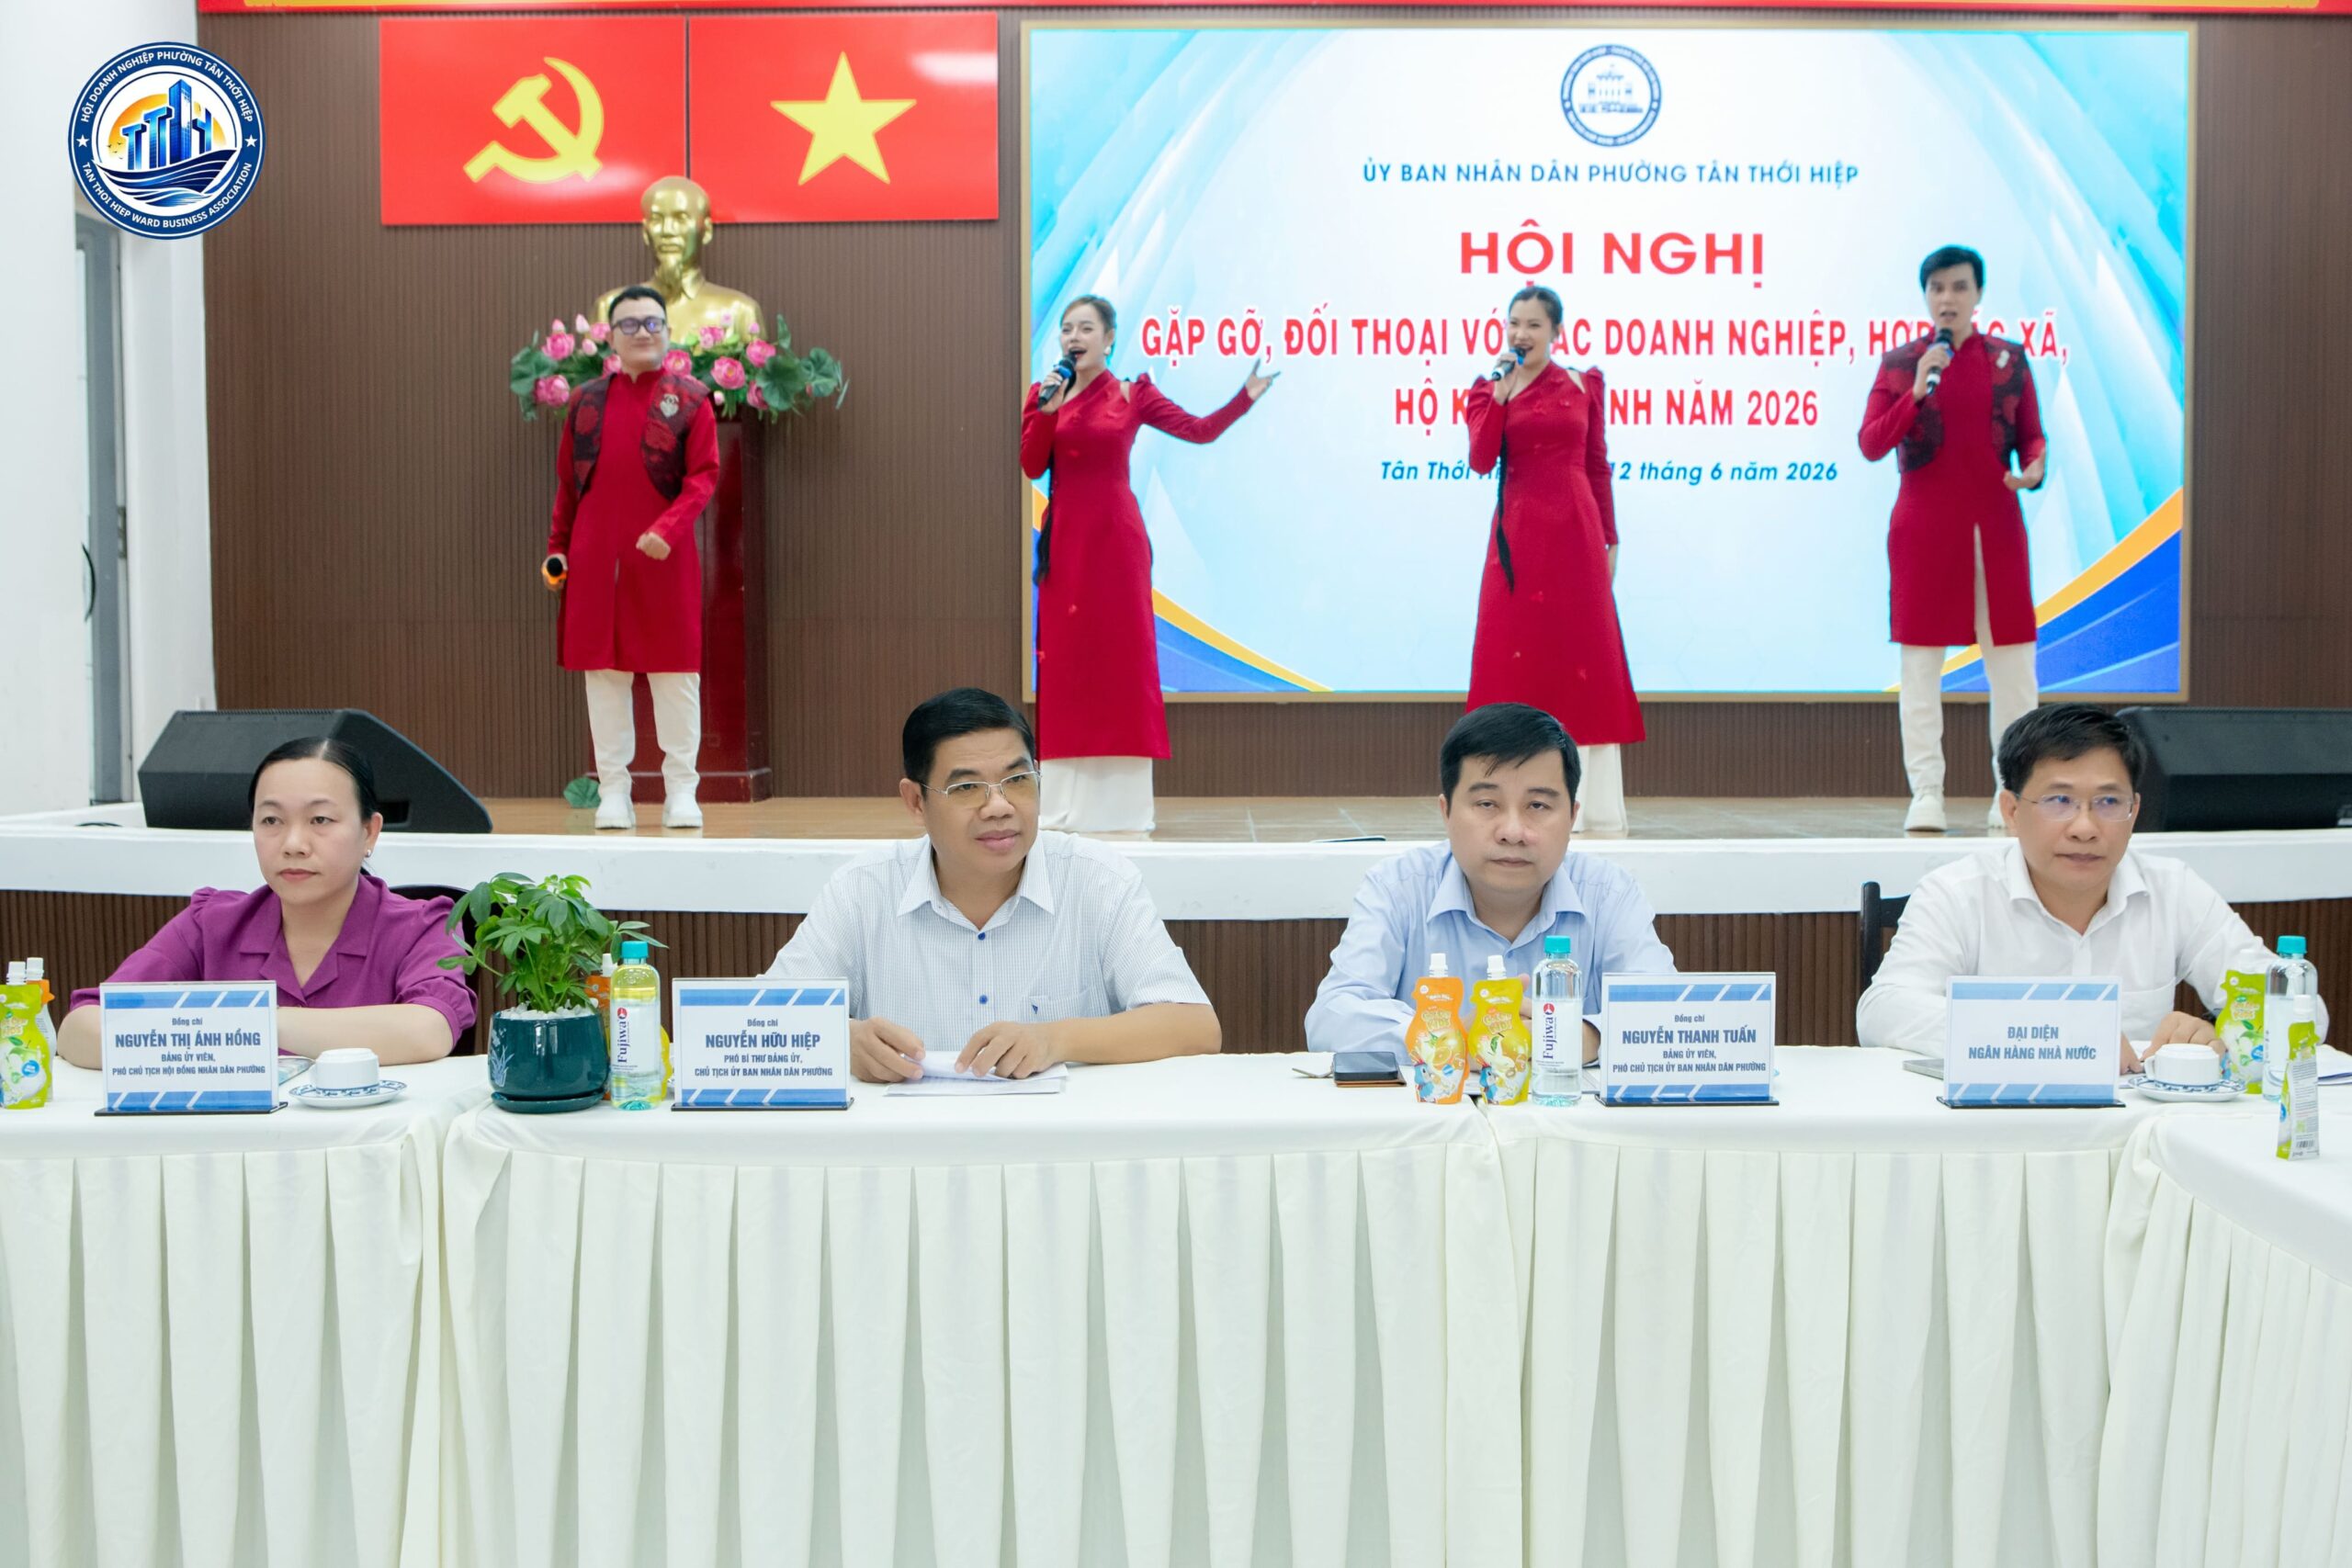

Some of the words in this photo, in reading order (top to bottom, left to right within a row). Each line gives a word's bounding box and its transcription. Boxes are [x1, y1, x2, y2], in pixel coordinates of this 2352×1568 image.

[1363, 157, 1391, 182] ỦY
[1401, 164, 1447, 182] BAN
[1457, 159, 1521, 182] NHÂN
[1532, 159, 1578, 182] DÂN
[1589, 159, 1687, 183] PHƯỜNG
[1697, 159, 1738, 182] TÂN
[1748, 158, 1799, 183] THỚI
[1811, 160, 1859, 188] HIỆP
[1461, 219, 1573, 287] HỘI
[1604, 231, 1763, 288] NGHỊ
[1142, 309, 1204, 367] GẶP
[1217, 309, 1272, 363] GỠ,
[1283, 304, 1338, 356] ĐỐI
[1351, 318, 1447, 366] THOẠI
[1605, 320, 1713, 356] DOANH
[1729, 310, 1855, 367] NGHIỆP,
[1396, 378, 1438, 435] HỘ
[1667, 379, 1733, 425] NĂM
[1747, 389, 1818, 425] 2026
[1381, 460, 1419, 479] Tân
[1640, 461, 1702, 485] tháng
[1712, 462, 1723, 480] 6
[1731, 462, 1779, 480] năm
[1787, 462, 1838, 481] 2026
[116, 1030, 166, 1047] NGUYỄN
[171, 1033, 191, 1049] THỊ
[195, 1031, 220, 1046] ÁNH
[616, 1020, 630, 1063] Fujiwa
[706, 1030, 757, 1048] NGUYỄN
[762, 1032, 786, 1047] HỮU
[792, 1032, 820, 1050] HIỆP
[1543, 1017, 1557, 1059] Fujiwa
[1623, 1026, 1673, 1043] NGUYỄN
[1678, 1030, 1719, 1043] THANH
[1724, 1024, 1756, 1043] TUẤN
[2007, 1026, 2027, 1042] ĐẠI
[2031, 1024, 2059, 1042] DIỆN
[1969, 1045, 2000, 1059] NGÂN
[2004, 1045, 2034, 1059] HÀNG
[2039, 1045, 2062, 1059] NHÀ
[743, 1067, 758, 1076] BAN
[1678, 1064, 1692, 1072] BAN
